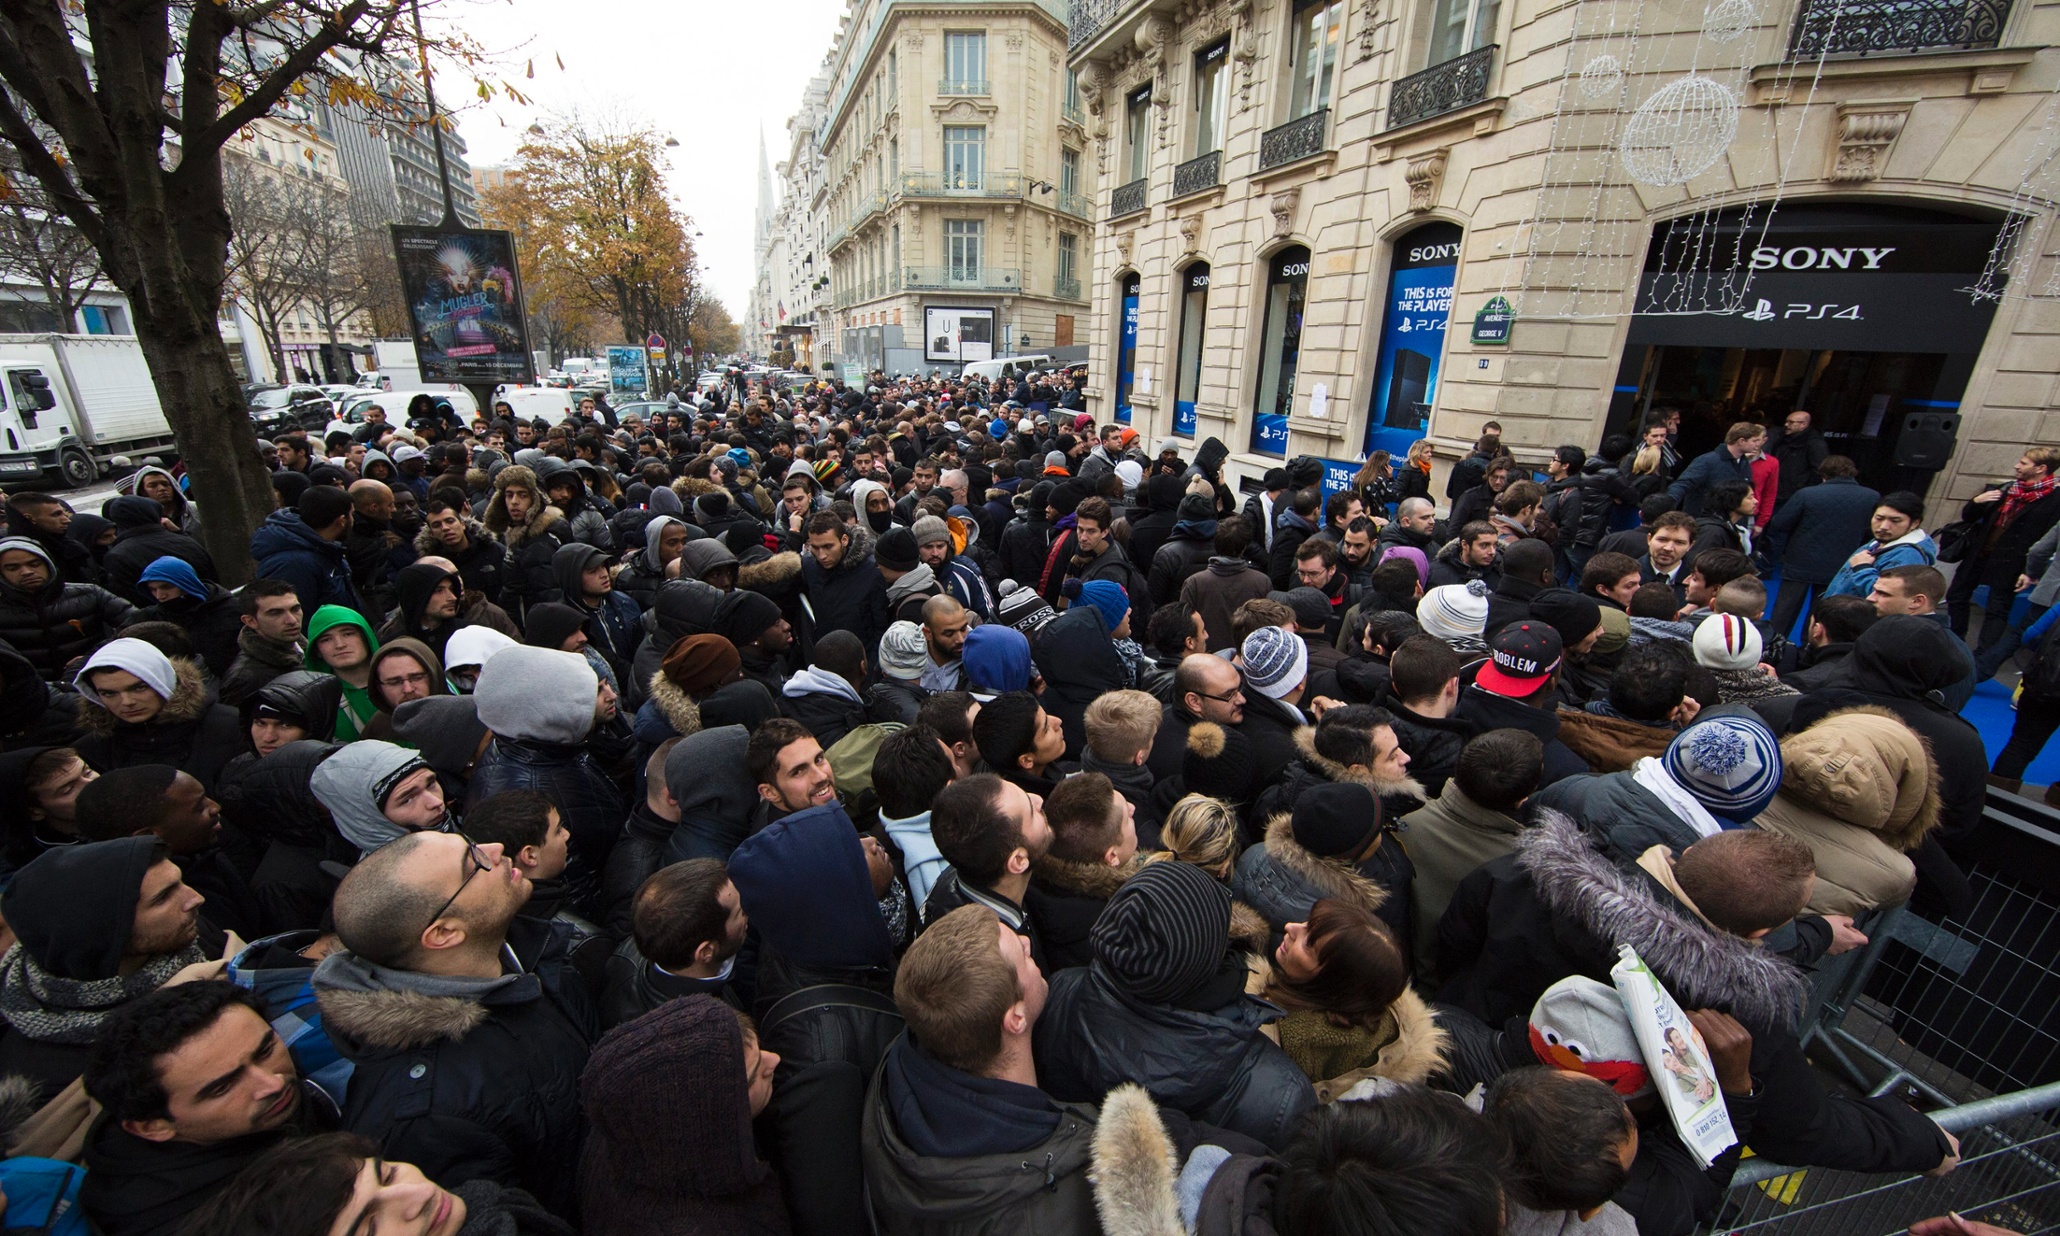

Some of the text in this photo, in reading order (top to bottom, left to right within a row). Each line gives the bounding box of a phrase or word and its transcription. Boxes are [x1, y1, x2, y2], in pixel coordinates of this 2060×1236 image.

[1748, 247, 1896, 270] SONY
[1404, 286, 1426, 300] THIS
[1426, 287, 1435, 298] IS
[437, 291, 494, 319] MUGLER
[1398, 300, 1413, 311] THE
[1782, 303, 1861, 320] PS4
[1478, 329, 1503, 337] GEORGE V
[1329, 468, 1348, 481] THIS
[1325, 479, 1339, 490] THE
